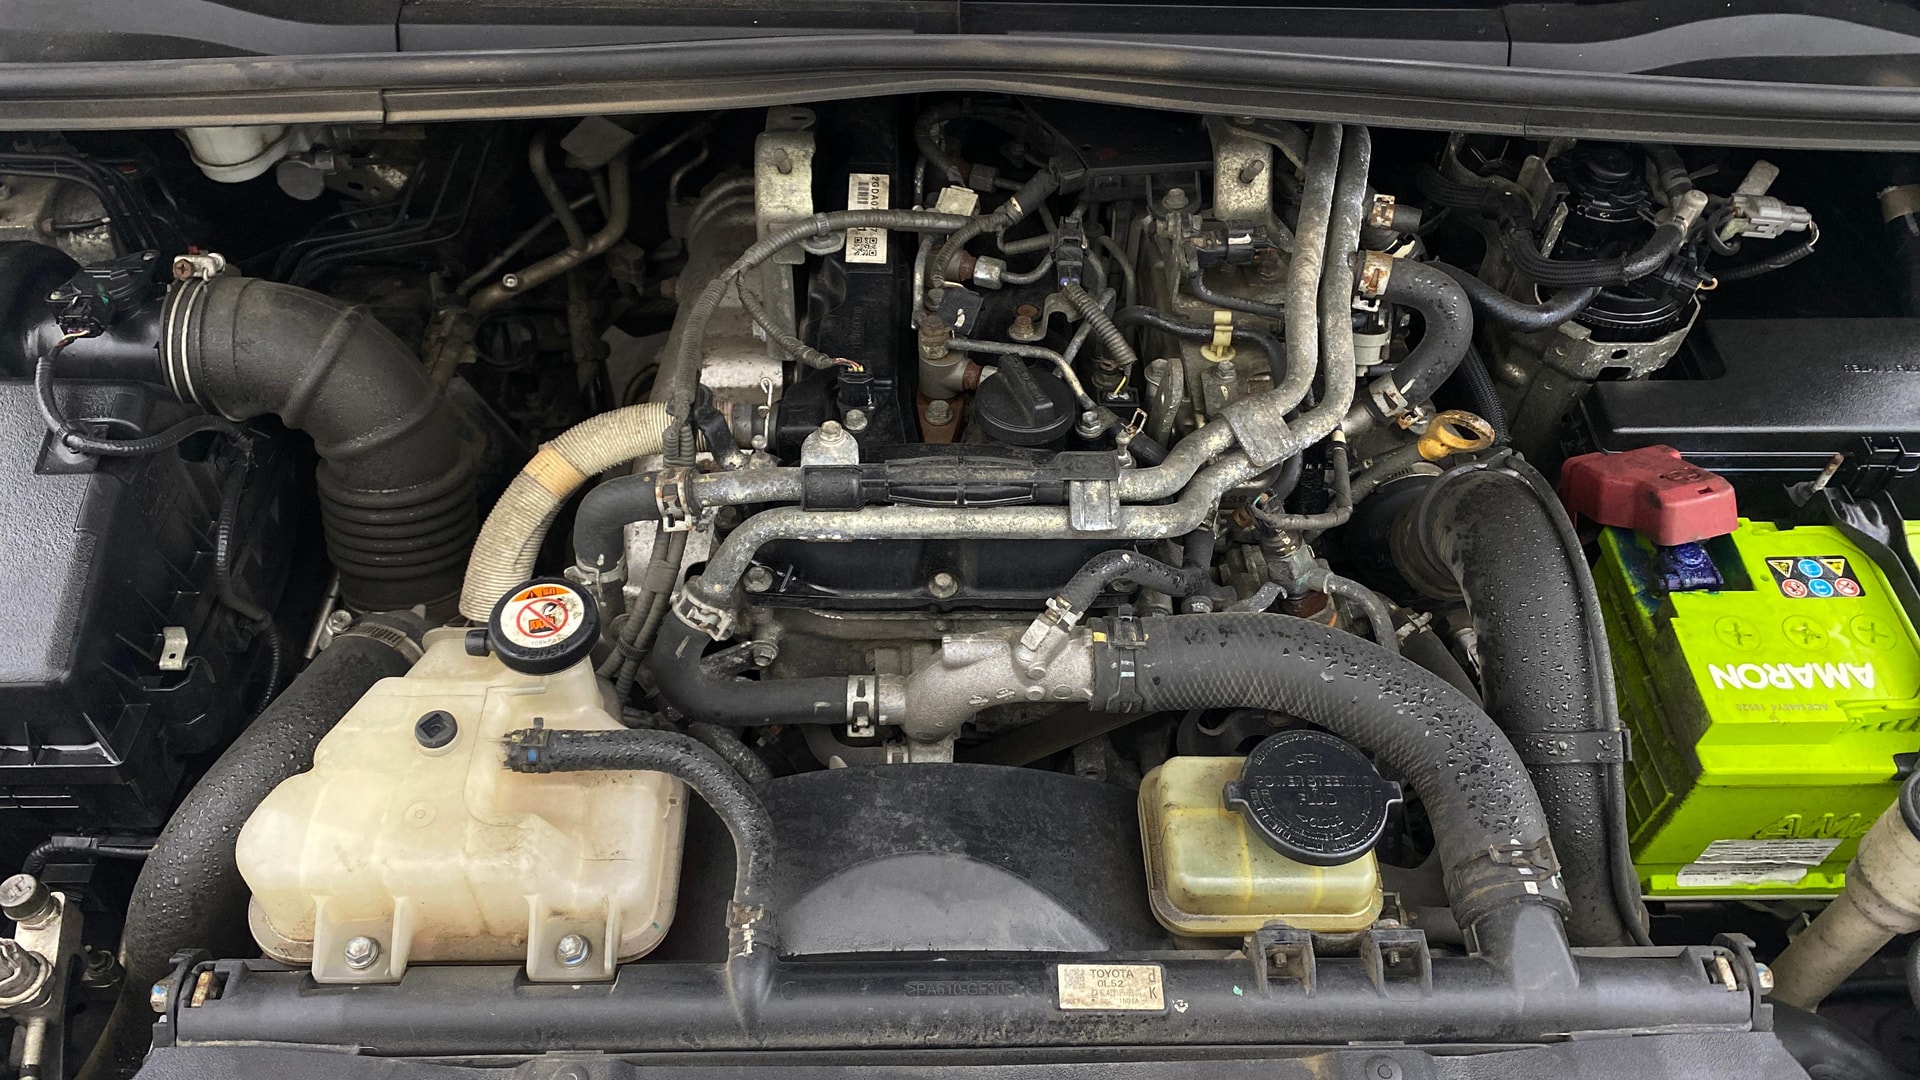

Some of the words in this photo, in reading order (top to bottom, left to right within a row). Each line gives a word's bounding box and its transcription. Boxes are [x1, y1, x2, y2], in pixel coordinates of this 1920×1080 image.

[1707, 662, 1875, 691] AMARON
[1255, 775, 1305, 787] POWER
[1090, 968, 1134, 978] TOYOTA
[1149, 987, 1157, 999] K
